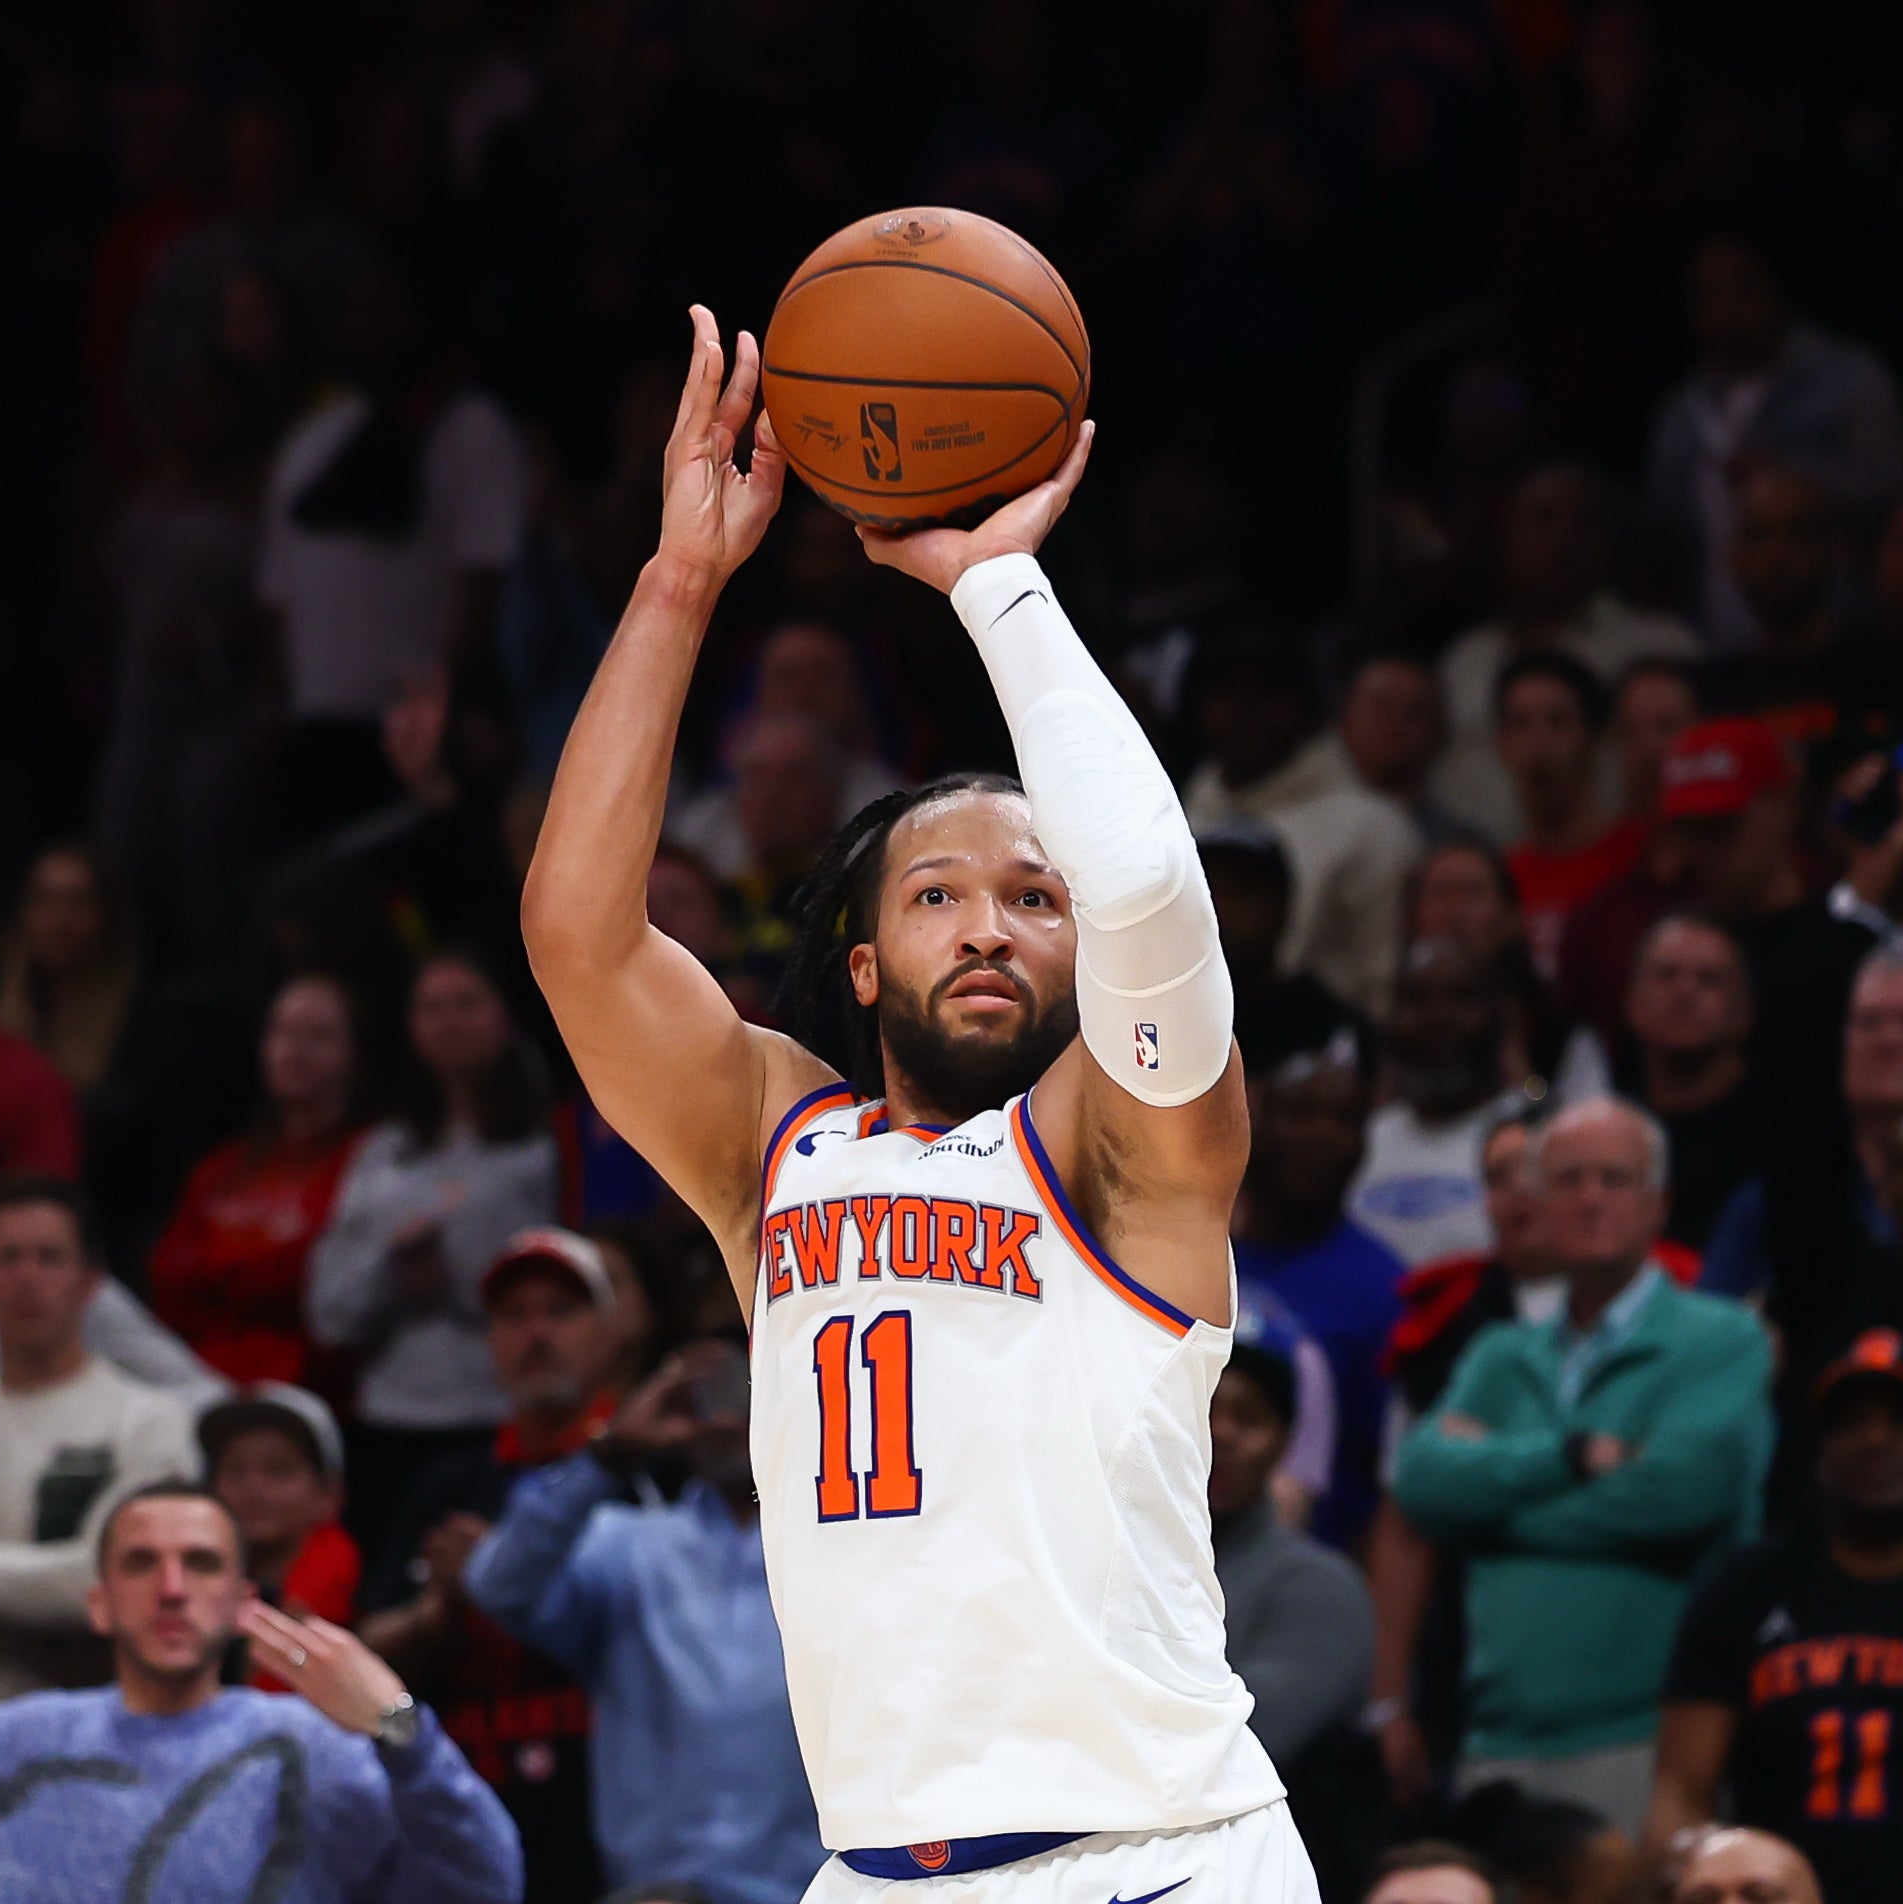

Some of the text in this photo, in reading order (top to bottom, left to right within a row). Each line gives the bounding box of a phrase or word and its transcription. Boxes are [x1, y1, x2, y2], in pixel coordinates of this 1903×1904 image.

[765, 1193, 1044, 1304] EW YORK
[812, 1310, 923, 1523] 11
[1804, 1706, 1895, 1821] 11
